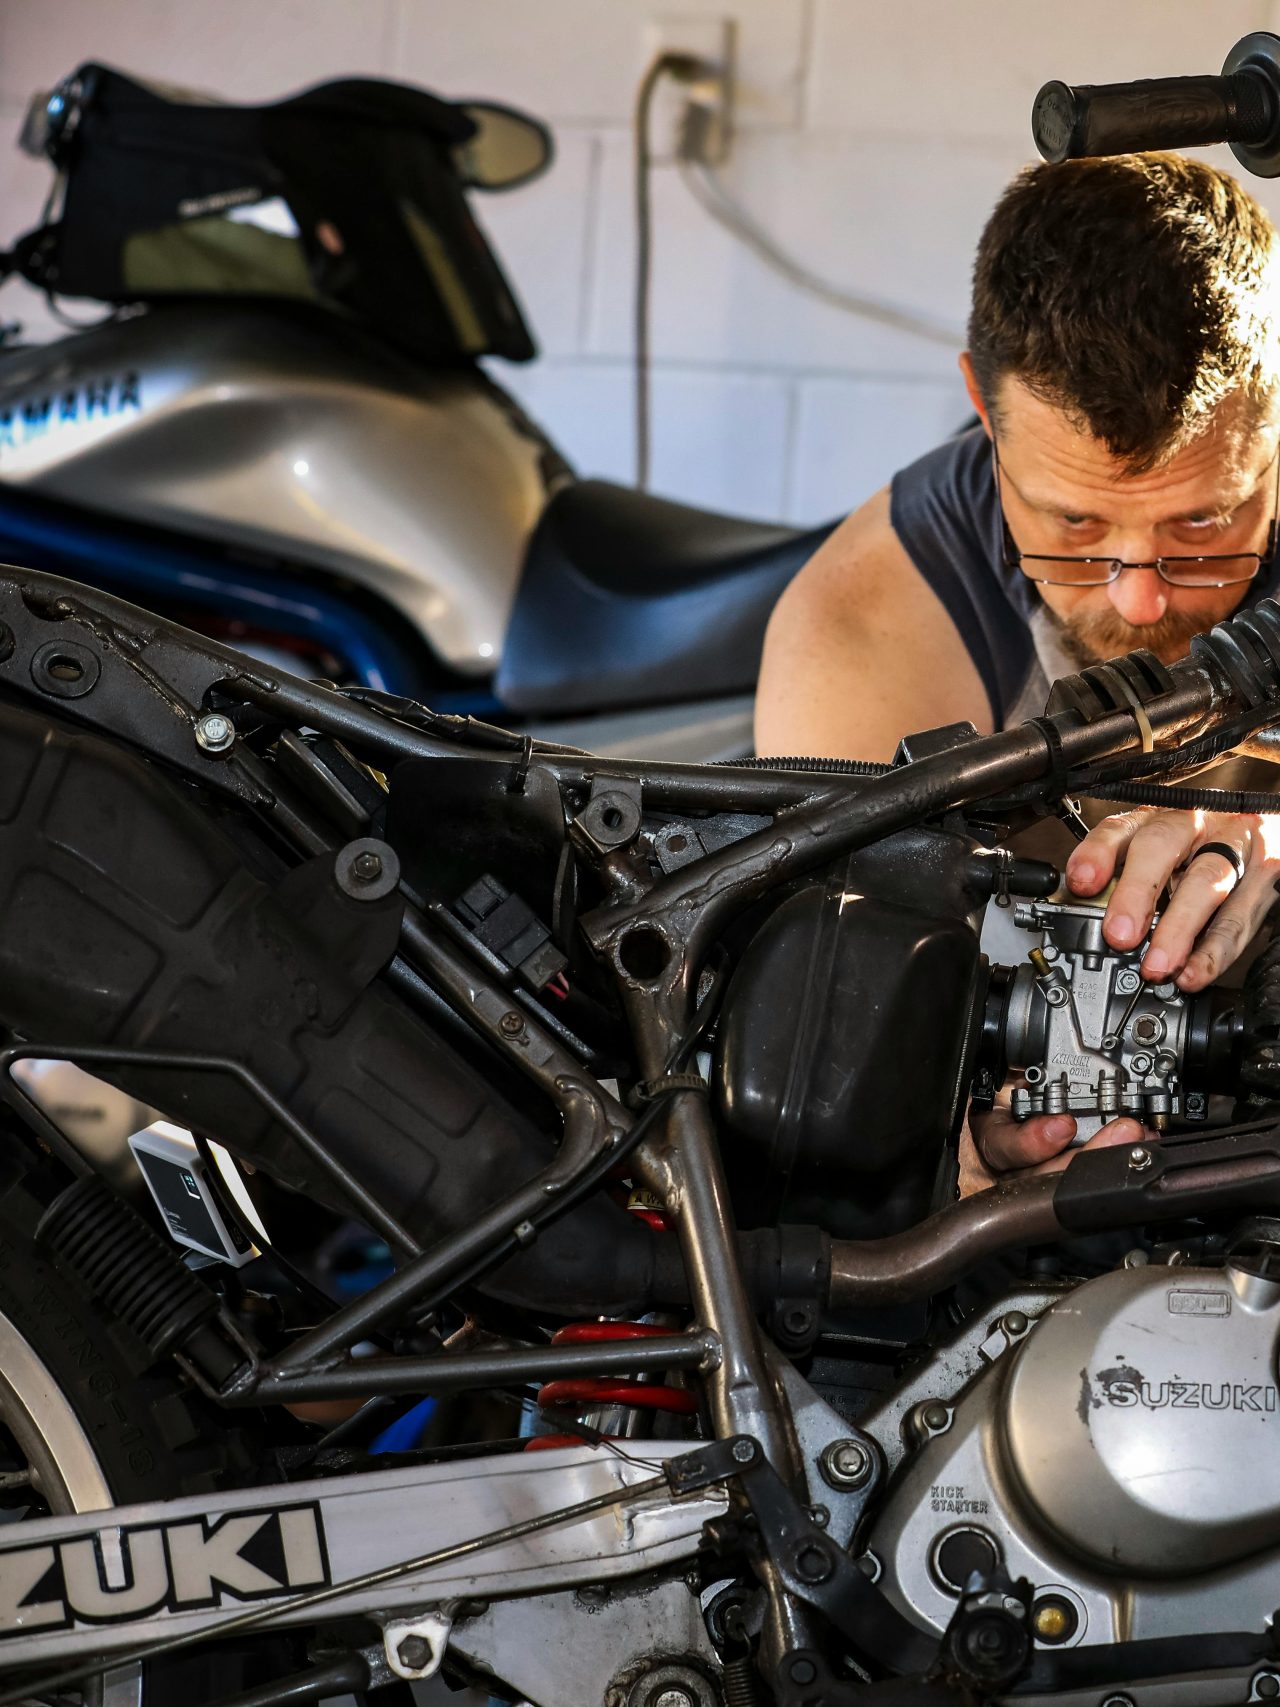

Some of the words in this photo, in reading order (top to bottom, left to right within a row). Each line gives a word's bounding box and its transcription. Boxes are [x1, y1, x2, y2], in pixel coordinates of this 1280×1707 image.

[1108, 1380, 1276, 1413] SUZUKI
[930, 1485, 965, 1499] KICK
[930, 1499, 989, 1515] STARTER
